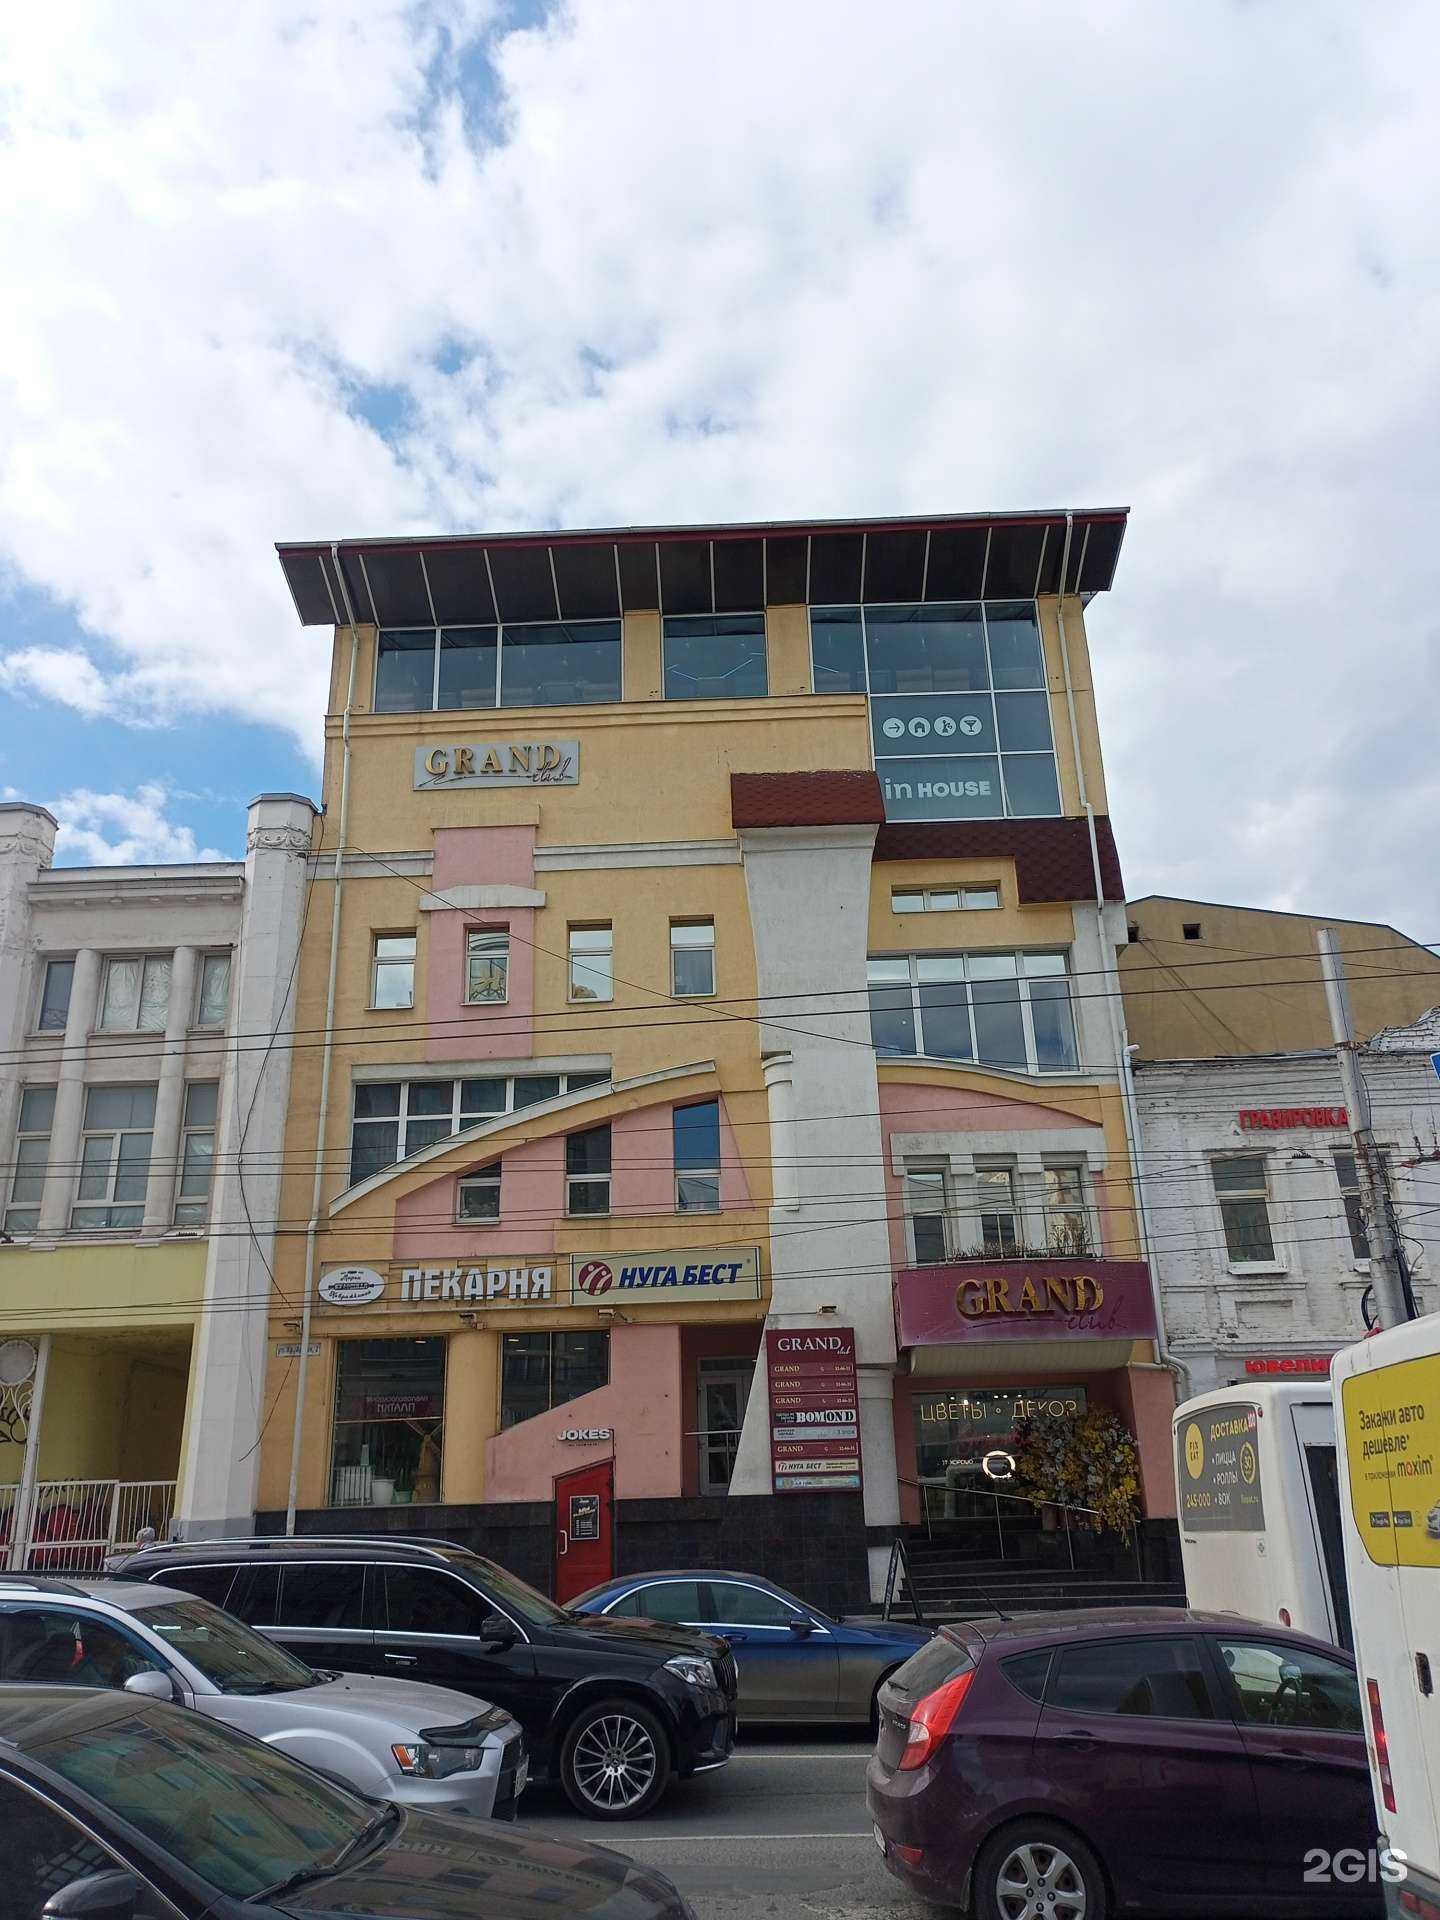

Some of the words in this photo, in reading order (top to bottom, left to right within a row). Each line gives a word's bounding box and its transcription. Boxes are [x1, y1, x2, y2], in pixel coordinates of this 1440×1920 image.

[425, 744, 561, 775] GRAND
[884, 778, 912, 799] in
[917, 781, 992, 798] HOUSE
[1239, 1107, 1348, 1129] ГРАВИРОВКА
[401, 1265, 552, 1300] ПЕКАРНЯ
[619, 1266, 676, 1288] НУГА
[682, 1263, 743, 1285] БЕСТ
[956, 1275, 1104, 1317] GRAND
[777, 1336, 841, 1352] GRAND
[774, 1365, 800, 1373] GRAND
[921, 1401, 987, 1421] ЦВЕТЫ
[1359, 1409, 1396, 1430] Закажи
[1399, 1404, 1425, 1424] авто
[557, 1429, 610, 1441] JOKES
[1210, 1421, 1249, 1441] ДОСТАВКА
[1215, 1450, 1237, 1466] ПИЦЦА
[1397, 1455, 1432, 1477] maxim
[1216, 1472, 1239, 1486] РОЛЛЫ
